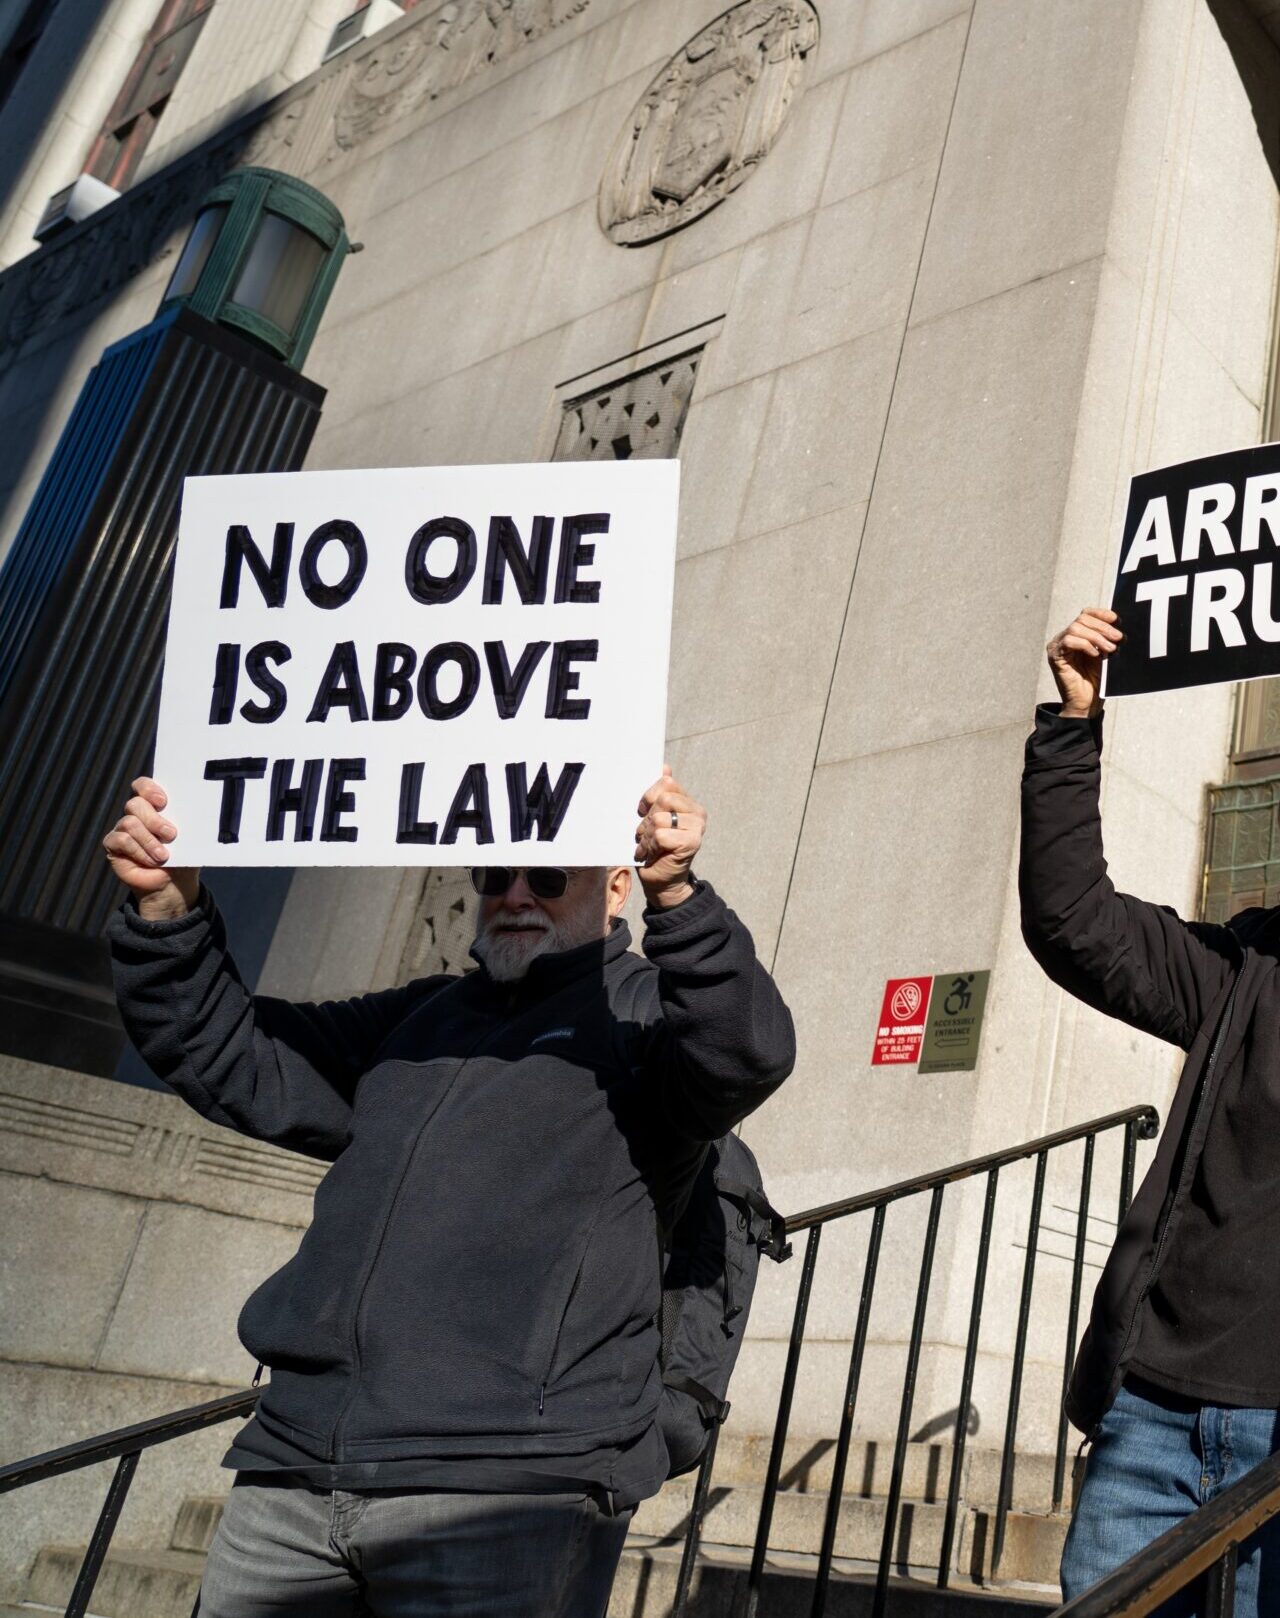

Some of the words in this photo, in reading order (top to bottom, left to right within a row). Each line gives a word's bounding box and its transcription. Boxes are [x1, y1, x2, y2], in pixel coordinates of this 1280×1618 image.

[219, 519, 368, 610] NO
[404, 513, 611, 606] ONE
[209, 640, 292, 725] IS
[306, 639, 599, 723] ABOVE
[203, 757, 367, 845] THE
[396, 761, 586, 845] LAW
[934, 1017, 975, 1026] ACCESSIBLE
[879, 1027, 890, 1037] NO
[891, 1025, 924, 1036] SMOKING
[935, 1027, 970, 1037] ENTRANCE
[877, 1037, 896, 1046] WITHIN
[907, 1036, 922, 1044] FEET
[881, 1045, 889, 1053] OF
[891, 1044, 915, 1053] BUILDING
[882, 1053, 910, 1061] ENTRANCE
